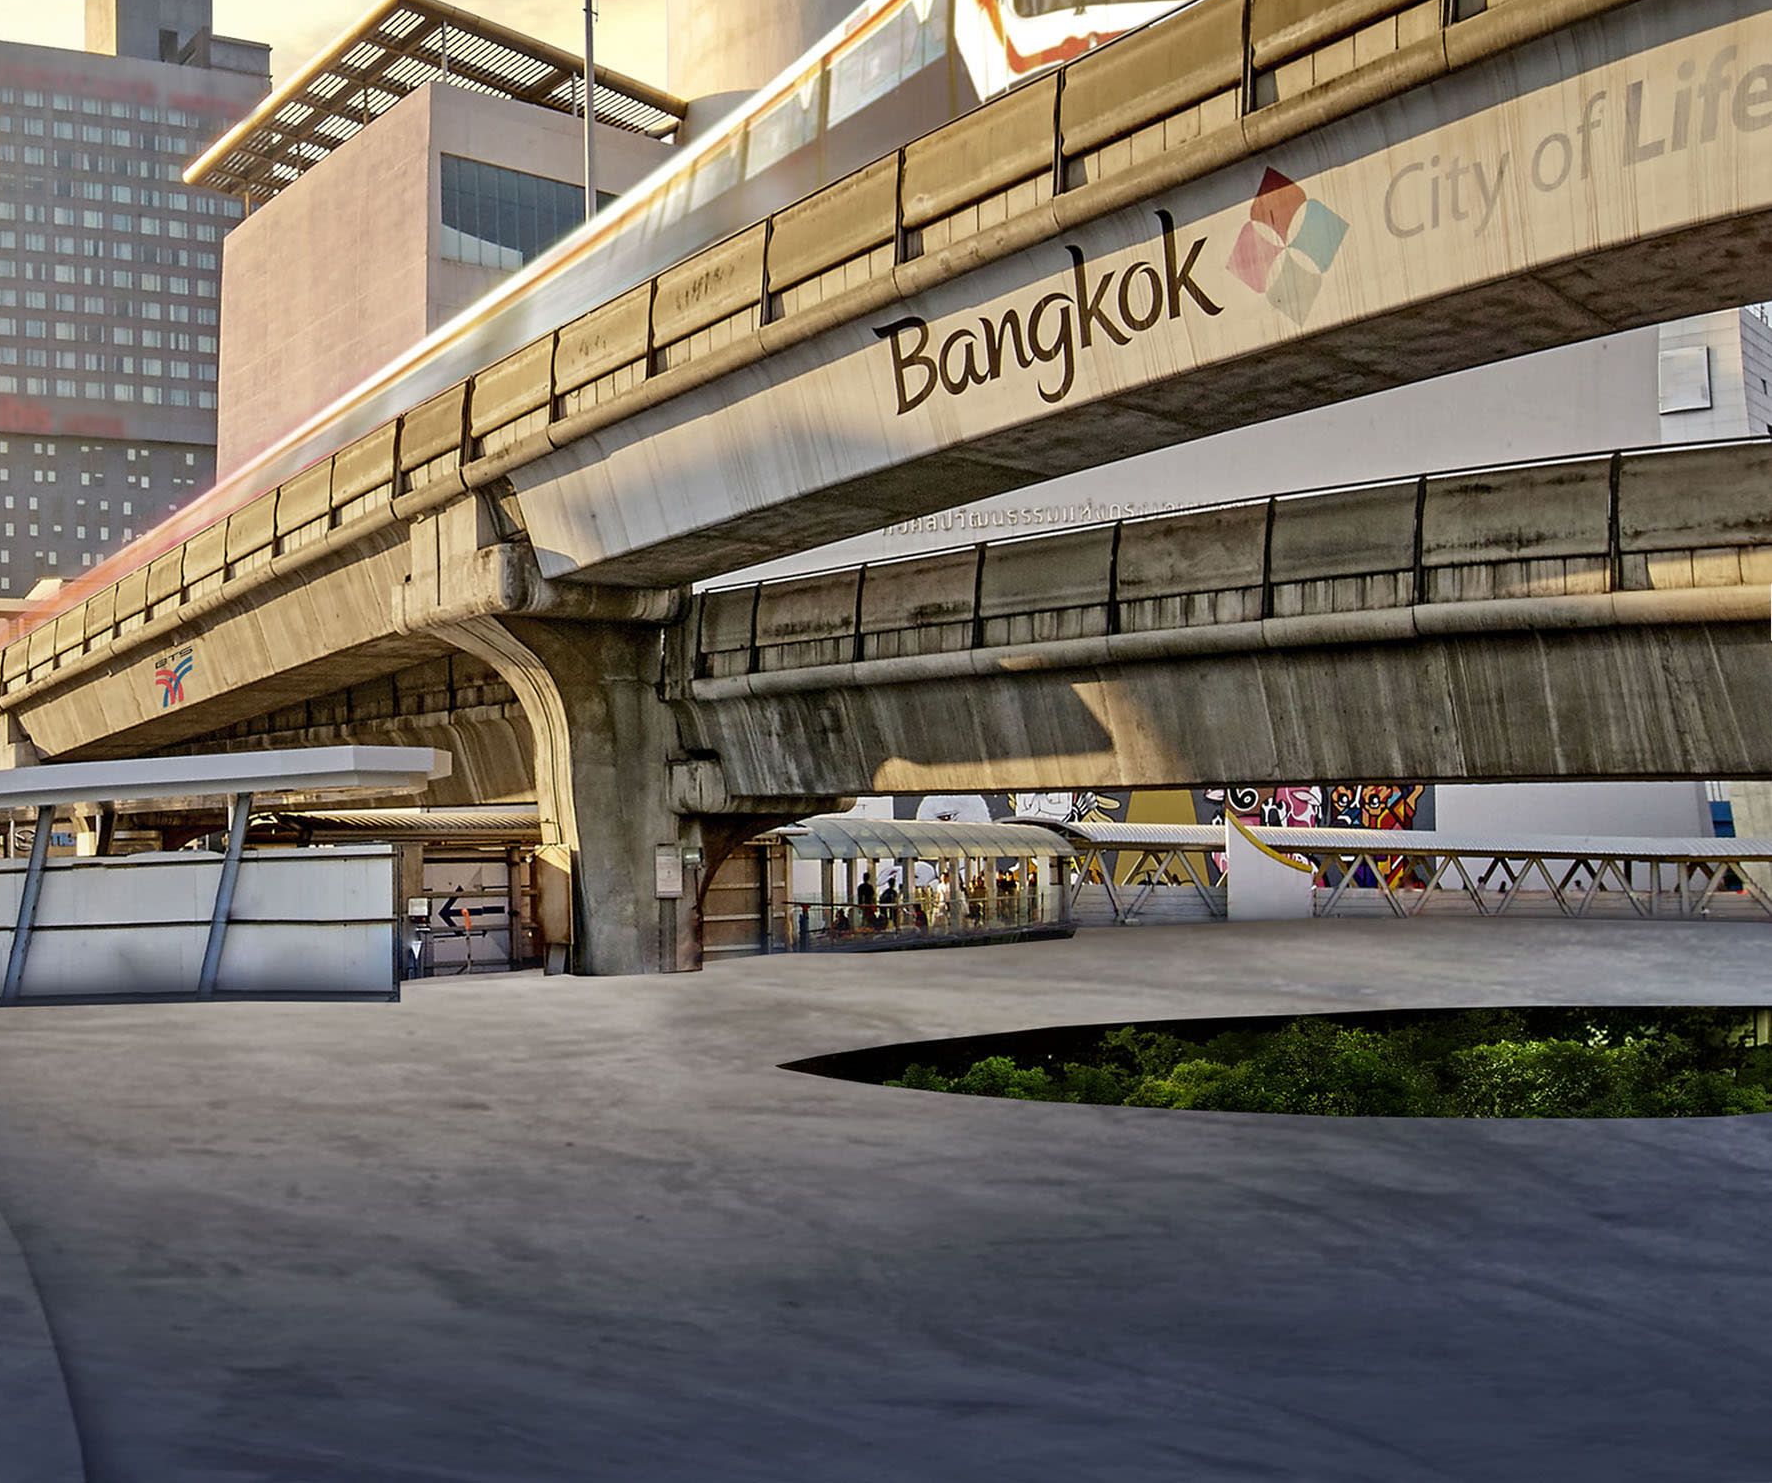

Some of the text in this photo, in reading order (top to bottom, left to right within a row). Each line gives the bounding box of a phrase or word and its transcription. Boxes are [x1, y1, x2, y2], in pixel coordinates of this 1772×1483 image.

[1383, 45, 1772, 239] City of Life
[872, 209, 1225, 416] Bangkok
[155, 645, 194, 669] BTS
